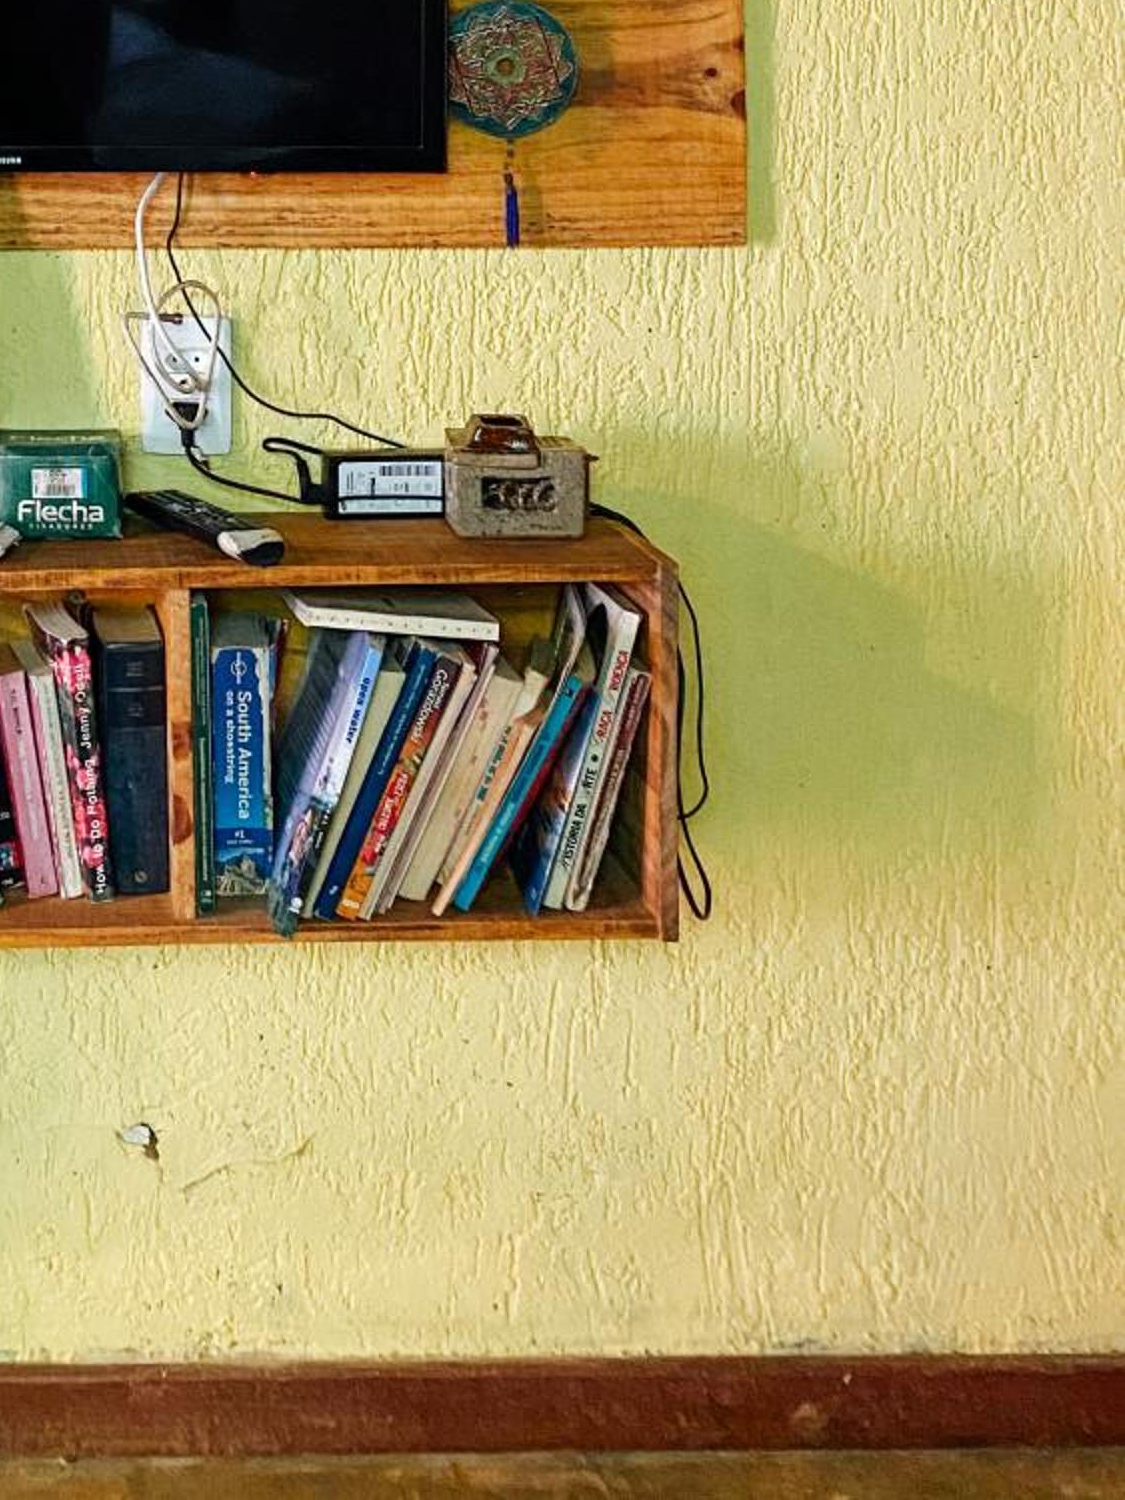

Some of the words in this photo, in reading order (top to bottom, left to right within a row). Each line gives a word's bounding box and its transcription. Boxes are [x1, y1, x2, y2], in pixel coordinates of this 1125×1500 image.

[17, 499, 104, 522] Flecha
[225, 690, 234, 707] on
[354, 676, 375, 707] open
[410, 667, 448, 745] Gorazdowski
[76, 708, 94, 749] Jenny
[236, 691, 253, 742] South
[342, 708, 365, 746] water
[222, 719, 237, 784] shoestring
[80, 759, 100, 815] Nothing
[236, 747, 254, 820] America
[89, 820, 101, 839] Do
[92, 845, 102, 858] to
[93, 867, 105, 894] How
